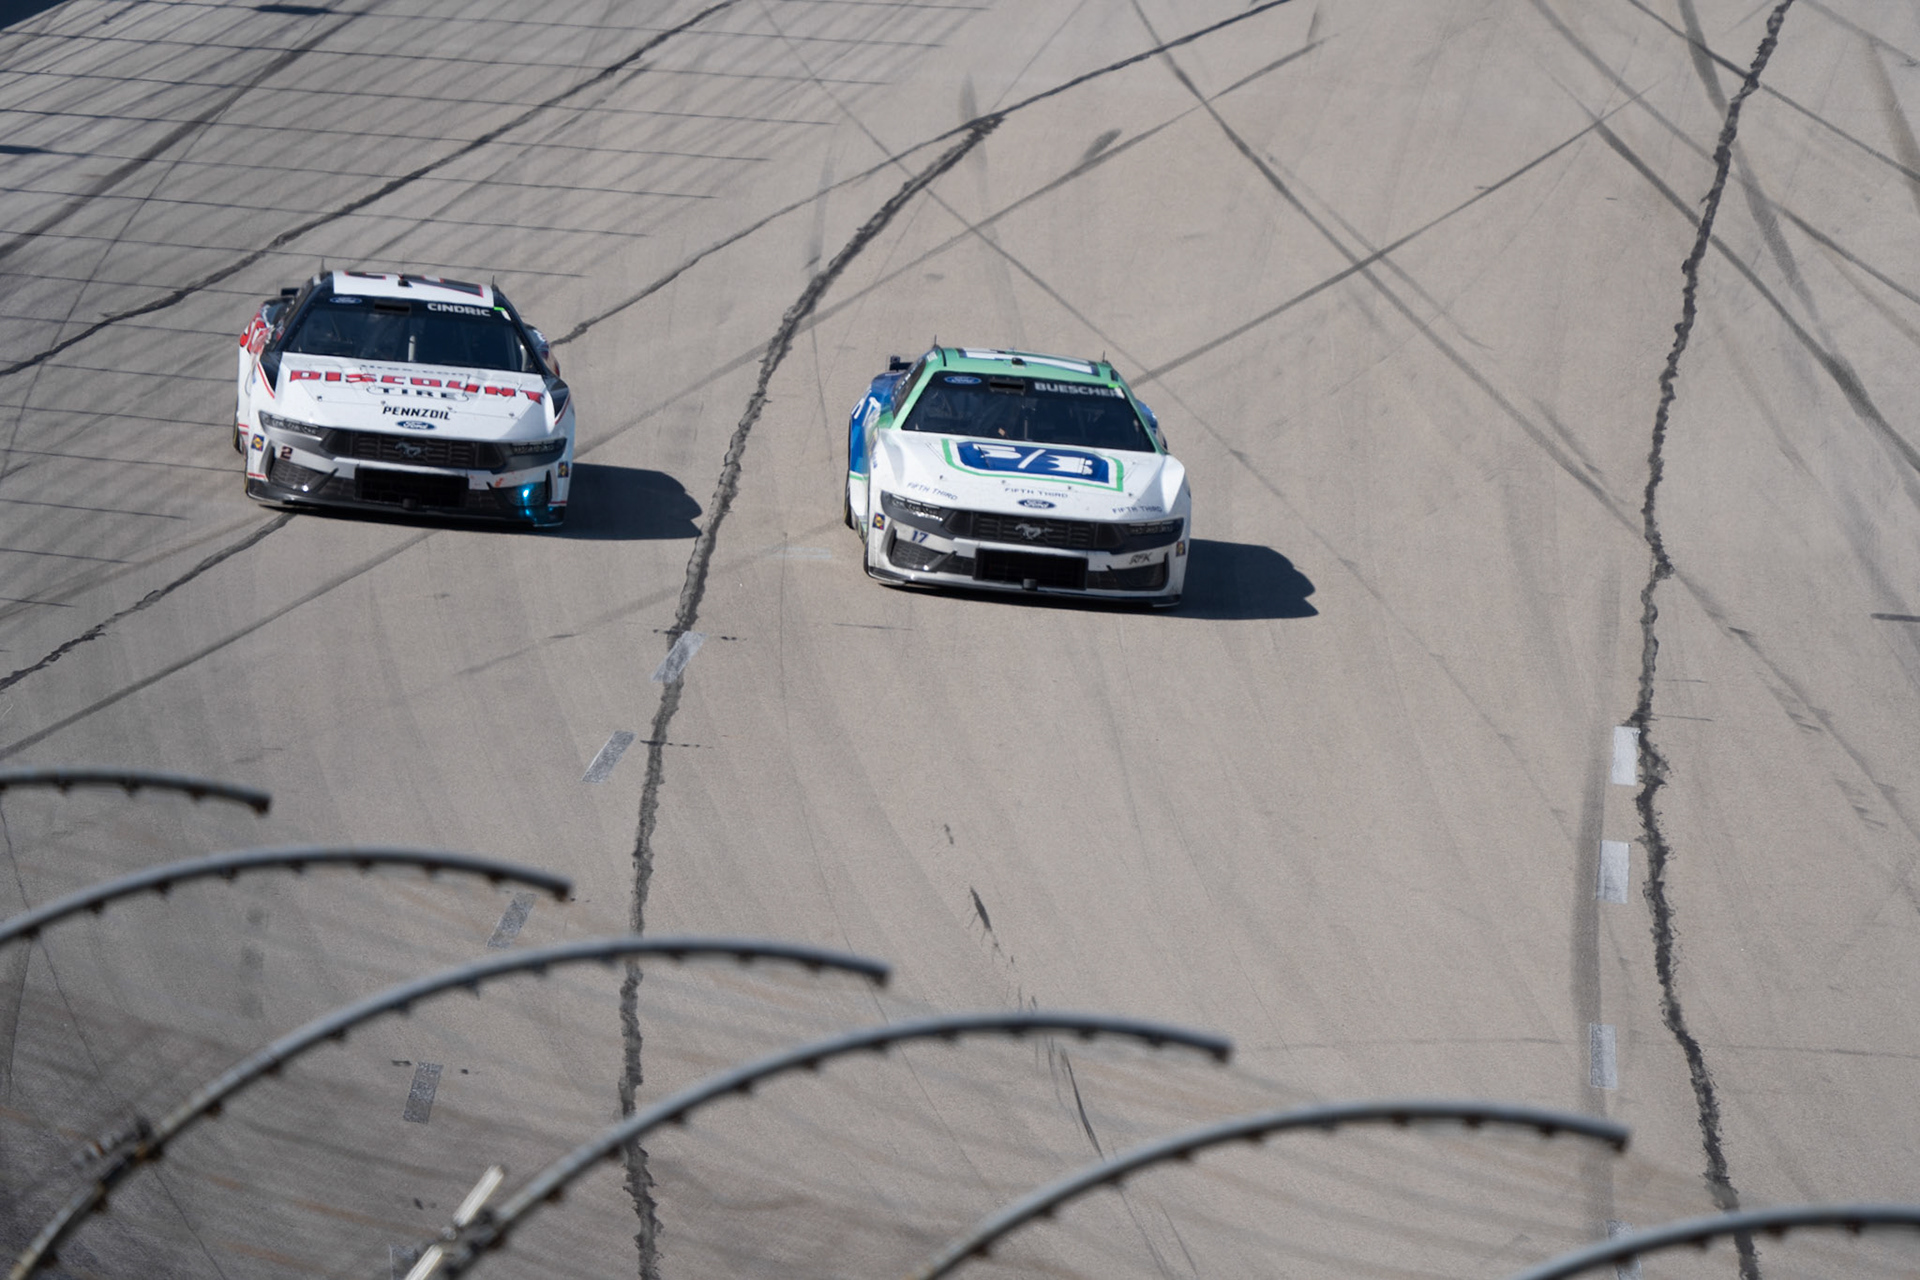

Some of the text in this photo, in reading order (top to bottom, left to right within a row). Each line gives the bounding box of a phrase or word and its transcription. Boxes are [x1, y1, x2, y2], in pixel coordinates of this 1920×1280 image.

[427, 302, 491, 318] CINDRIC
[289, 369, 544, 405] DISCOUNT
[378, 386, 462, 400] TIRE
[382, 405, 451, 421] PENNZOIL
[280, 445, 294, 461] 2
[908, 482, 958, 501] FIFTH THIRD
[1004, 487, 1069, 499] FIFTH THIRD
[1140, 505, 1163, 513] THIRD
[912, 530, 929, 544] 17
